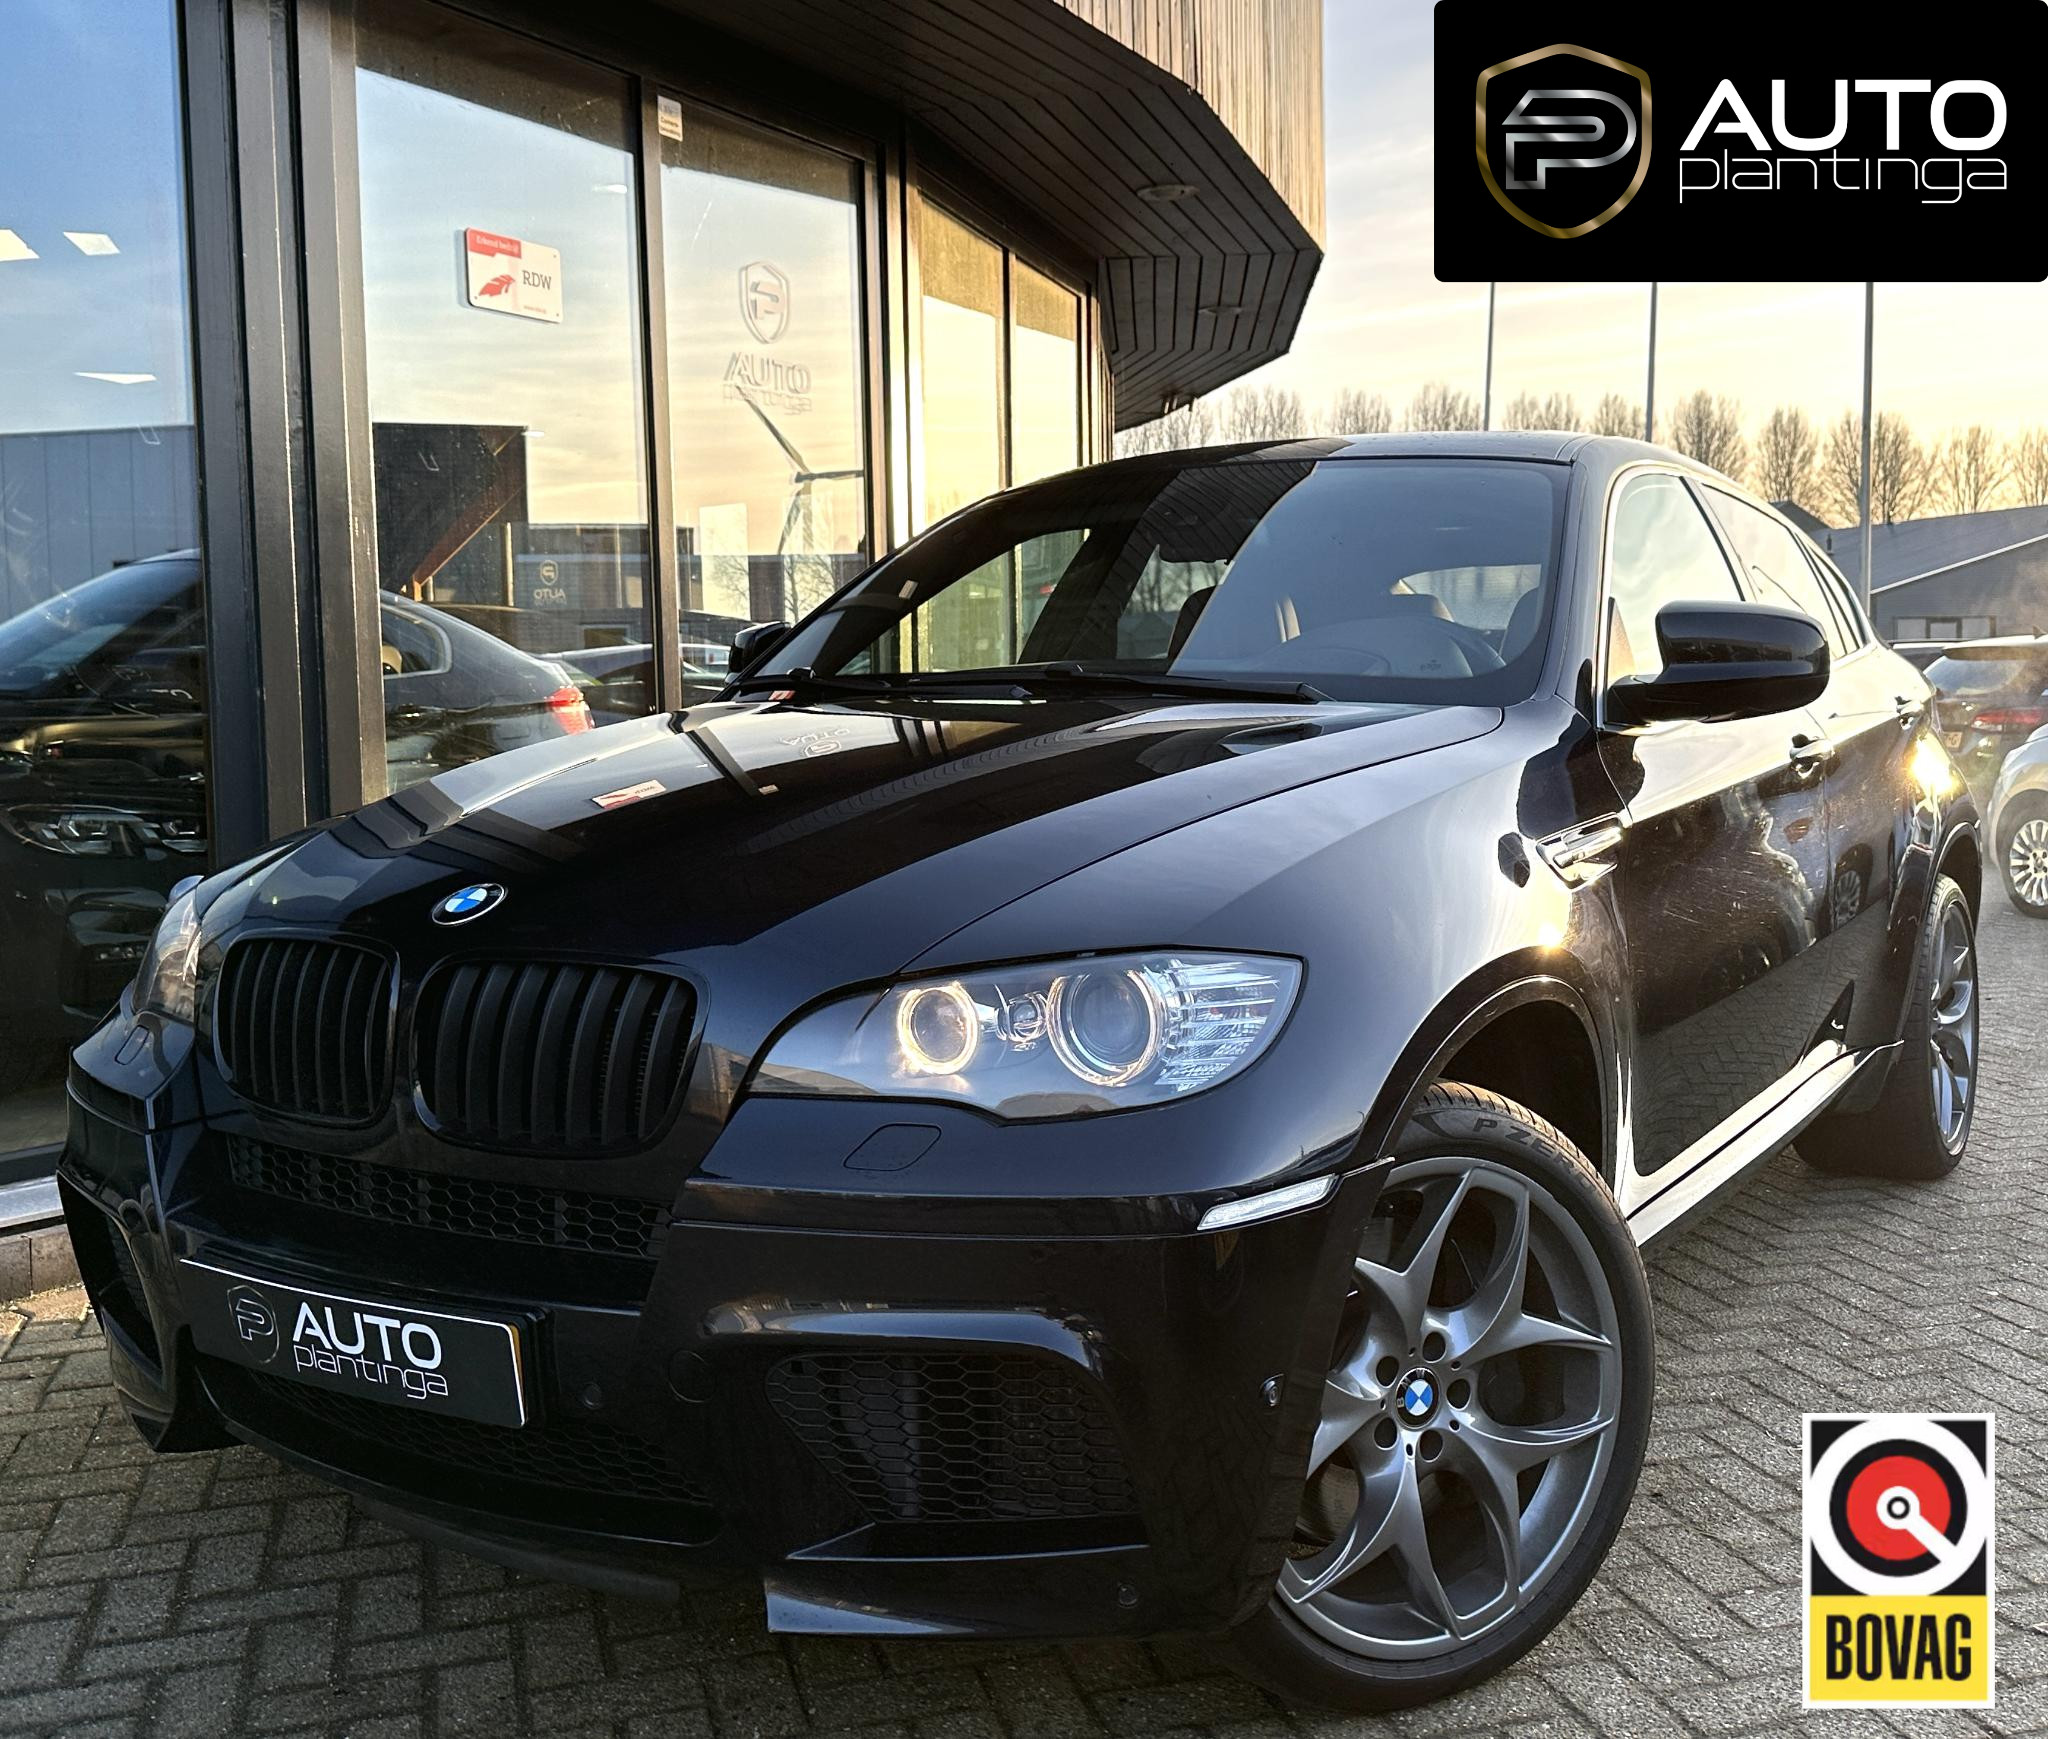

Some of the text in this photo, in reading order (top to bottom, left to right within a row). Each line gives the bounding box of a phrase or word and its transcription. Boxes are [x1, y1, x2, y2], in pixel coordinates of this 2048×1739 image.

[522, 270, 552, 290] RDW
[724, 352, 812, 394] AUTO
[1473, 1118, 1498, 1132] P
[292, 1301, 442, 1370] AUTO
[293, 1343, 449, 1400] plantinga
